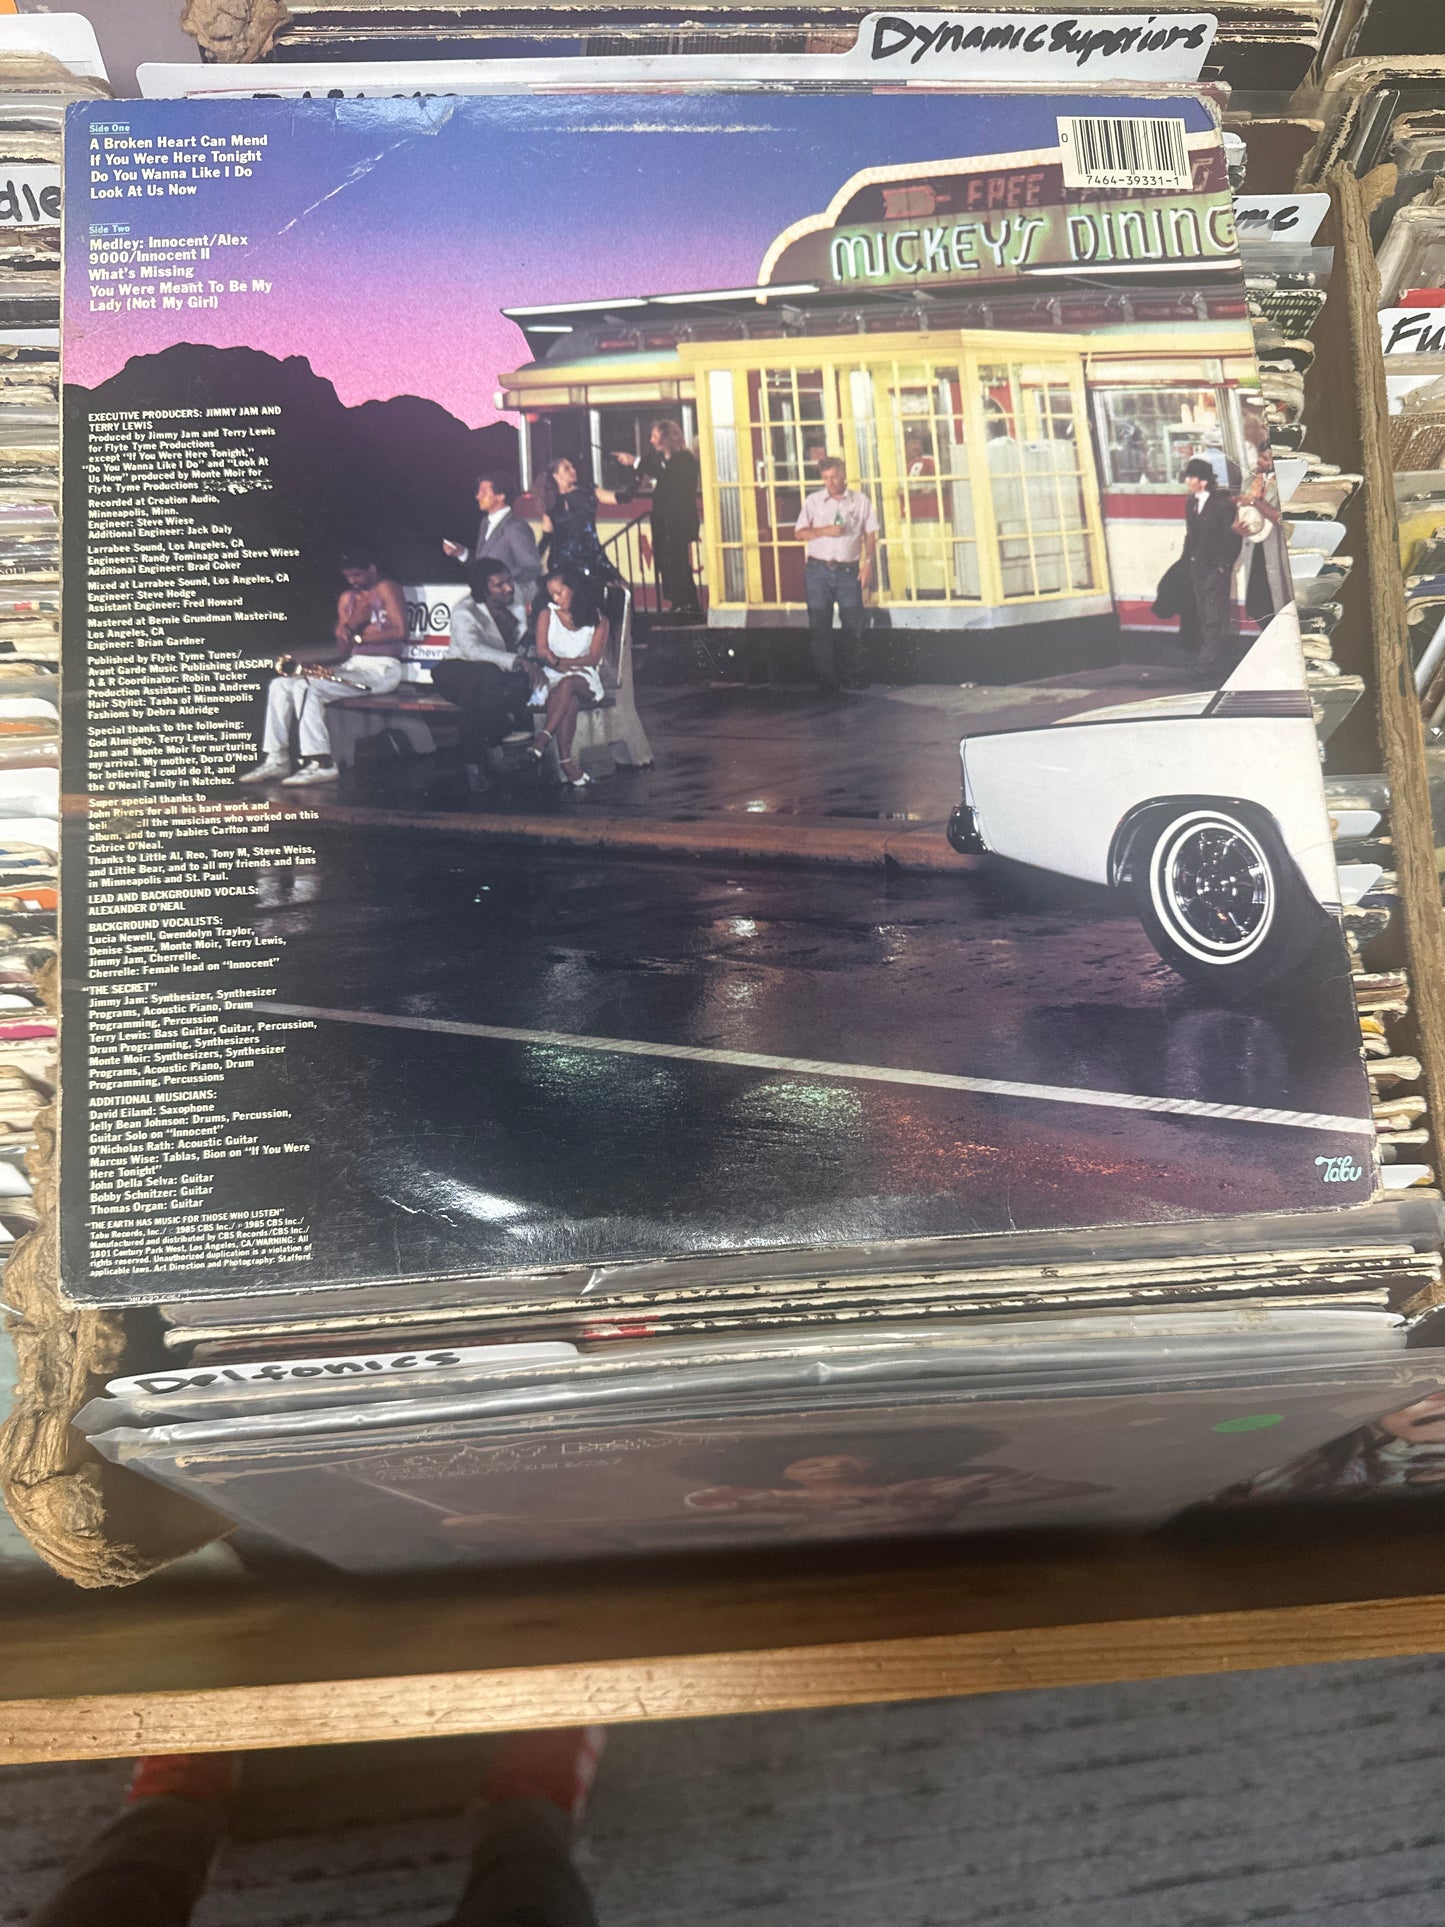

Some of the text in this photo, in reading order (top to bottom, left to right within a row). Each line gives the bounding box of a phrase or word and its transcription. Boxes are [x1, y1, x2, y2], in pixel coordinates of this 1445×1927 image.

[89, 124, 130, 133] Side One
[90, 135, 268, 150] A Broken Heart Can Mend
[1061, 132, 1069, 143] 0
[90, 150, 262, 166] If You Were Here Tonight
[91, 166, 253, 182] Do You Wanna Like I Do
[1086, 175, 1180, 186] 7464-39331-1
[91, 184, 198, 199] Look At Us Now
[89, 225, 130, 234] Side Two
[90, 234, 248, 251] Medley: Innocent/Alex
[830, 205, 1239, 282] MICKEY'S DINING
[89, 248, 210, 264] 9000/Innocent II
[88, 265, 195, 280] What's Missing
[90, 280, 272, 298] You Were Meant To Be My
[90, 296, 218, 312] Lady (Not My Girl)
[1384, 313, 1445, 354] Fu
[88, 406, 282, 422] EXECUTIVE PRODUCERS: JIMMY JAM AND
[89, 421, 153, 432] TERRY LEWIS
[88, 427, 276, 443] Produced by Jimmy Jam and Terry Lewis
[88, 440, 215, 453] for Flyte Tyme Productions
[88, 494, 220, 508] Recorded at Creation Audio,
[88, 507, 179, 518] Minneapolis, Minn.
[88, 517, 194, 530] Engineer: Steve Wiese
[88, 525, 232, 539] Additional Engineer: Jack Daly
[87, 538, 245, 554] Larrabee Sound, Los Angeles, CA
[87, 618, 133, 627] Mastered
[135, 617, 146, 626] at
[182, 614, 232, 623] Grundman
[234, 612, 288, 621] Mastering,
[87, 637, 206, 651] Engineer: Brian Gardner
[87, 683, 261, 698] Production Assistant: Dina Andrews
[87, 721, 244, 736] Special thanks to the following:
[88, 886, 259, 904] LEAD AND BACKGROUND VOCALS:
[88, 902, 186, 915] ALEXANDER O'NEAL
[88, 916, 223, 932] BACKGROUND VOCALISTS:
[88, 928, 255, 944] Lucia Newell, Gwendolyn Traylor,
[88, 967, 140, 978] Cherrelle:
[142, 964, 180, 975] Female
[182, 962, 204, 972] lead
[89, 1090, 217, 1106] ADDITIONAL MUSICIANS:
[89, 1104, 215, 1120] David Eiland: Saxophone
[1315, 1154, 1362, 1182] Tabu
[89, 1174, 214, 1190] John Della Selva: Guitar
[89, 1186, 214, 1203] Bobby Schnitzer: Guitar
[89, 1199, 204, 1214] Thomas Organ: Guitar
[107, 1220, 134, 1228] EARTH
[136, 1218, 153, 1227] HAS
[154, 1216, 181, 1225] MUSIC
[182, 1215, 200, 1224] FOR
[201, 1213, 229, 1222] THOSE
[229, 1211, 249, 1220] WHO
[134, 1352, 461, 1395] Delfonics
